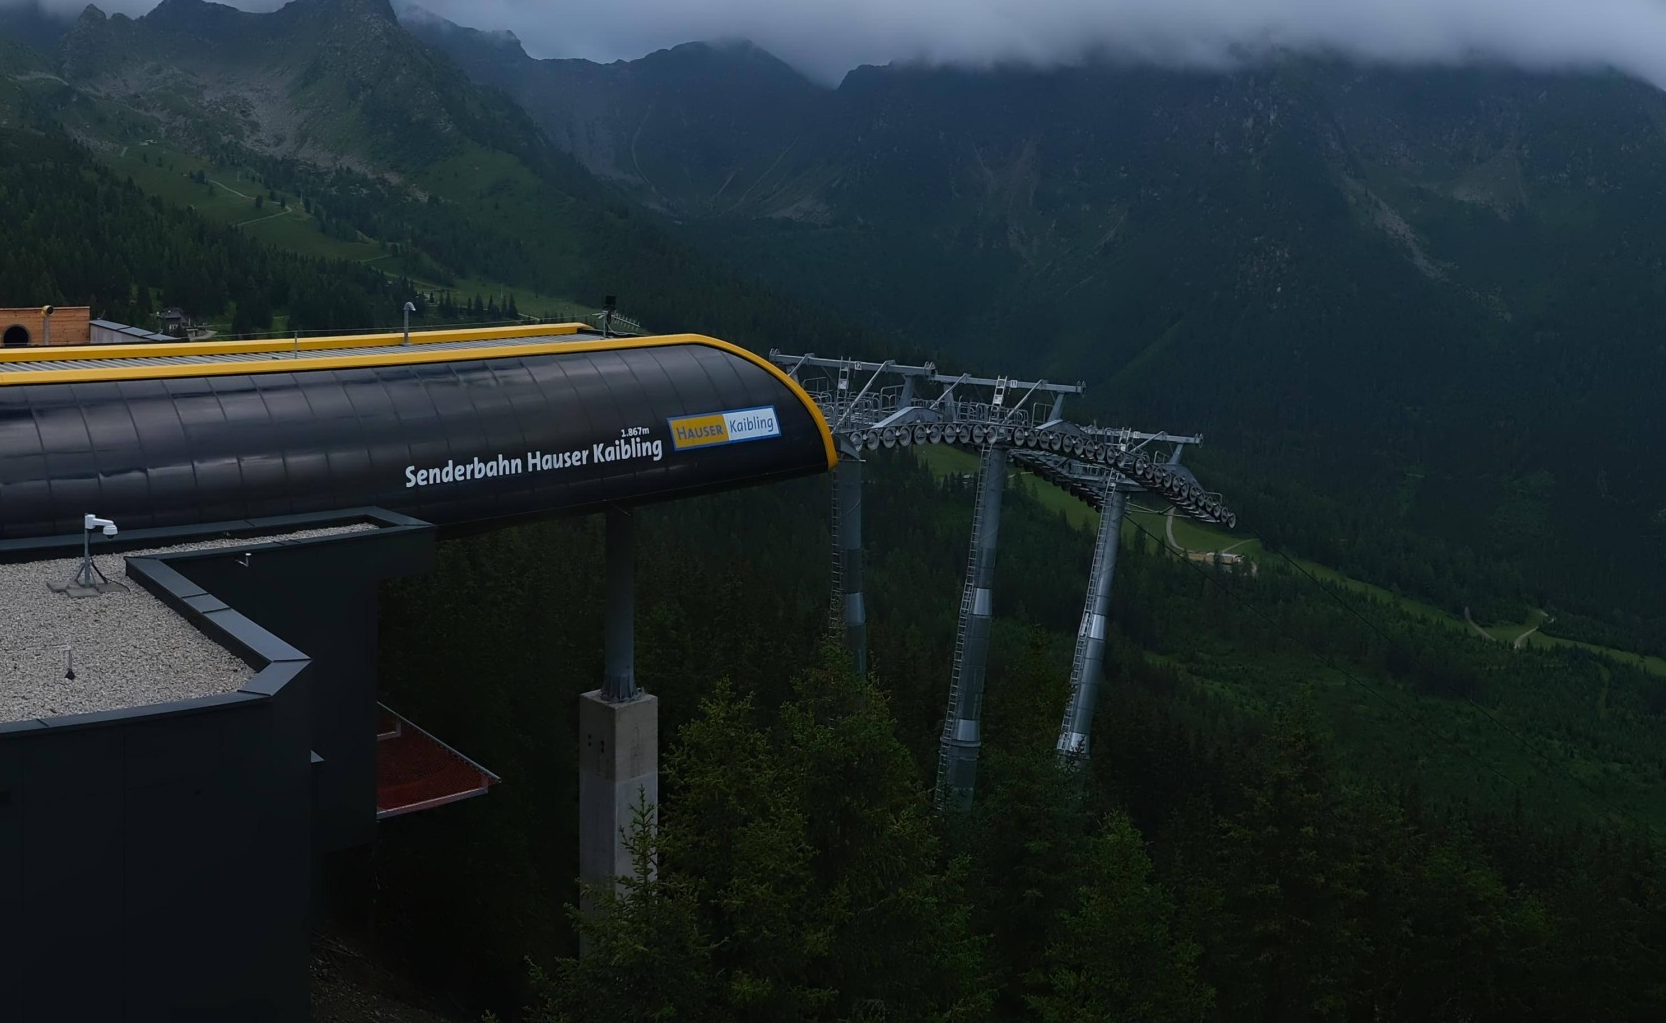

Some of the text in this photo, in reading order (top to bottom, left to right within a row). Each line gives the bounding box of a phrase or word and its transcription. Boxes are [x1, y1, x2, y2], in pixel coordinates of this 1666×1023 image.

[620, 427, 650, 438] 1.867m
[676, 416, 774, 441] HAUSER Kaibling
[405, 436, 663, 488] Senderbahn Hauser Kaibling
